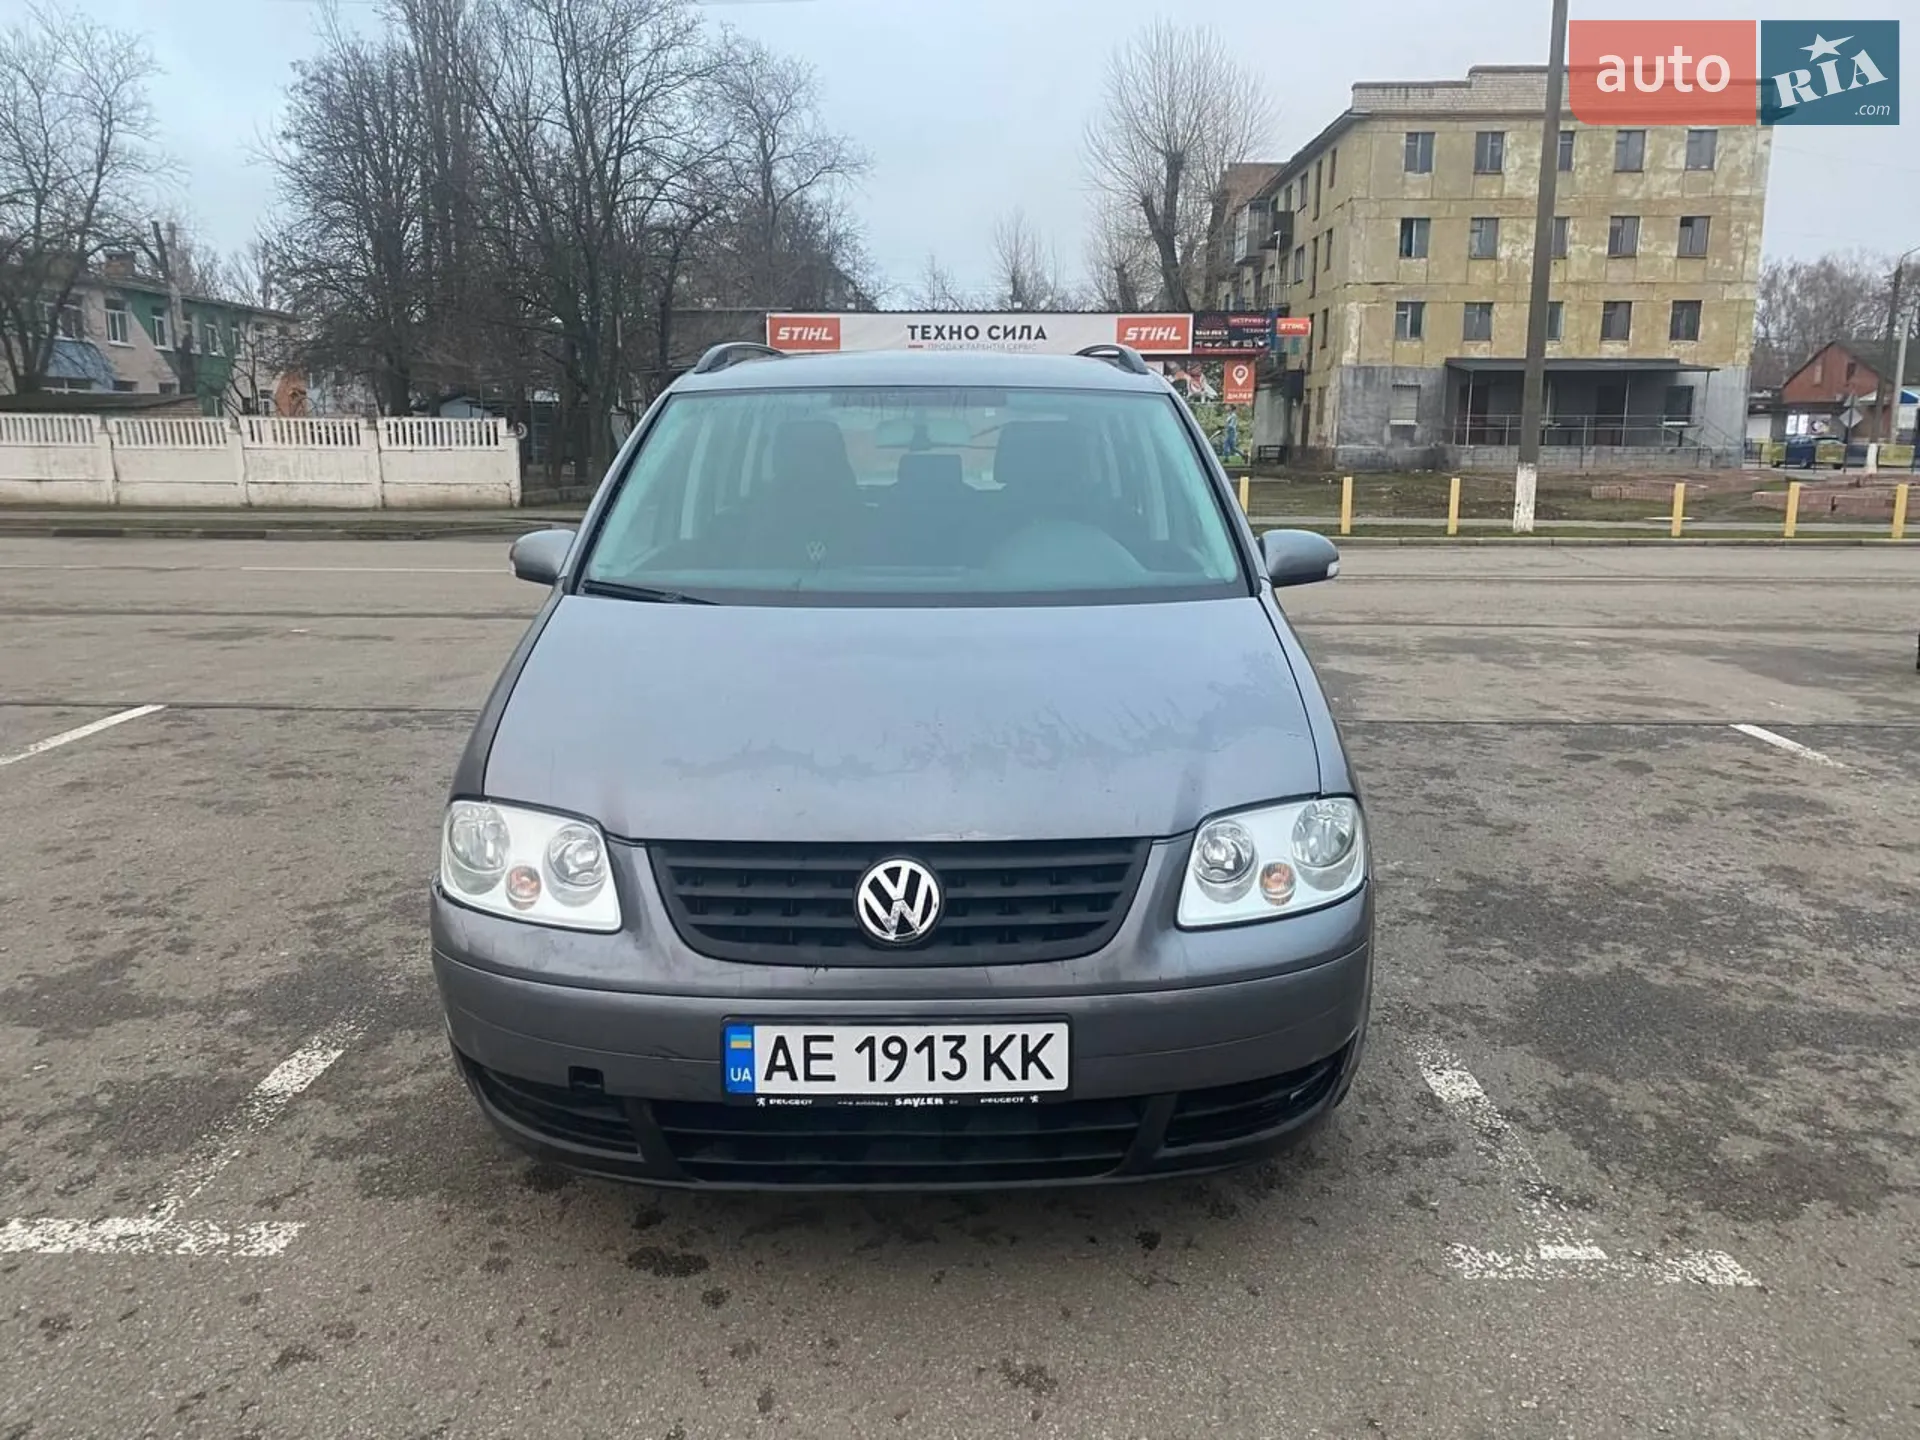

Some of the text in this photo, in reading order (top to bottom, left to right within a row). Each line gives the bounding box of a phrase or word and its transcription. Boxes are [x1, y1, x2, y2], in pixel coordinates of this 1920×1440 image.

[776, 326, 834, 341] STIHL
[907, 325, 1047, 340] ТЕХНО СИЛА
[1124, 327, 1182, 341] STIHL
[1280, 323, 1306, 331] STIHL
[763, 1033, 1056, 1082] AE 1913 KK
[730, 1067, 752, 1082] UA
[980, 1096, 1025, 1104] PEUGEOT
